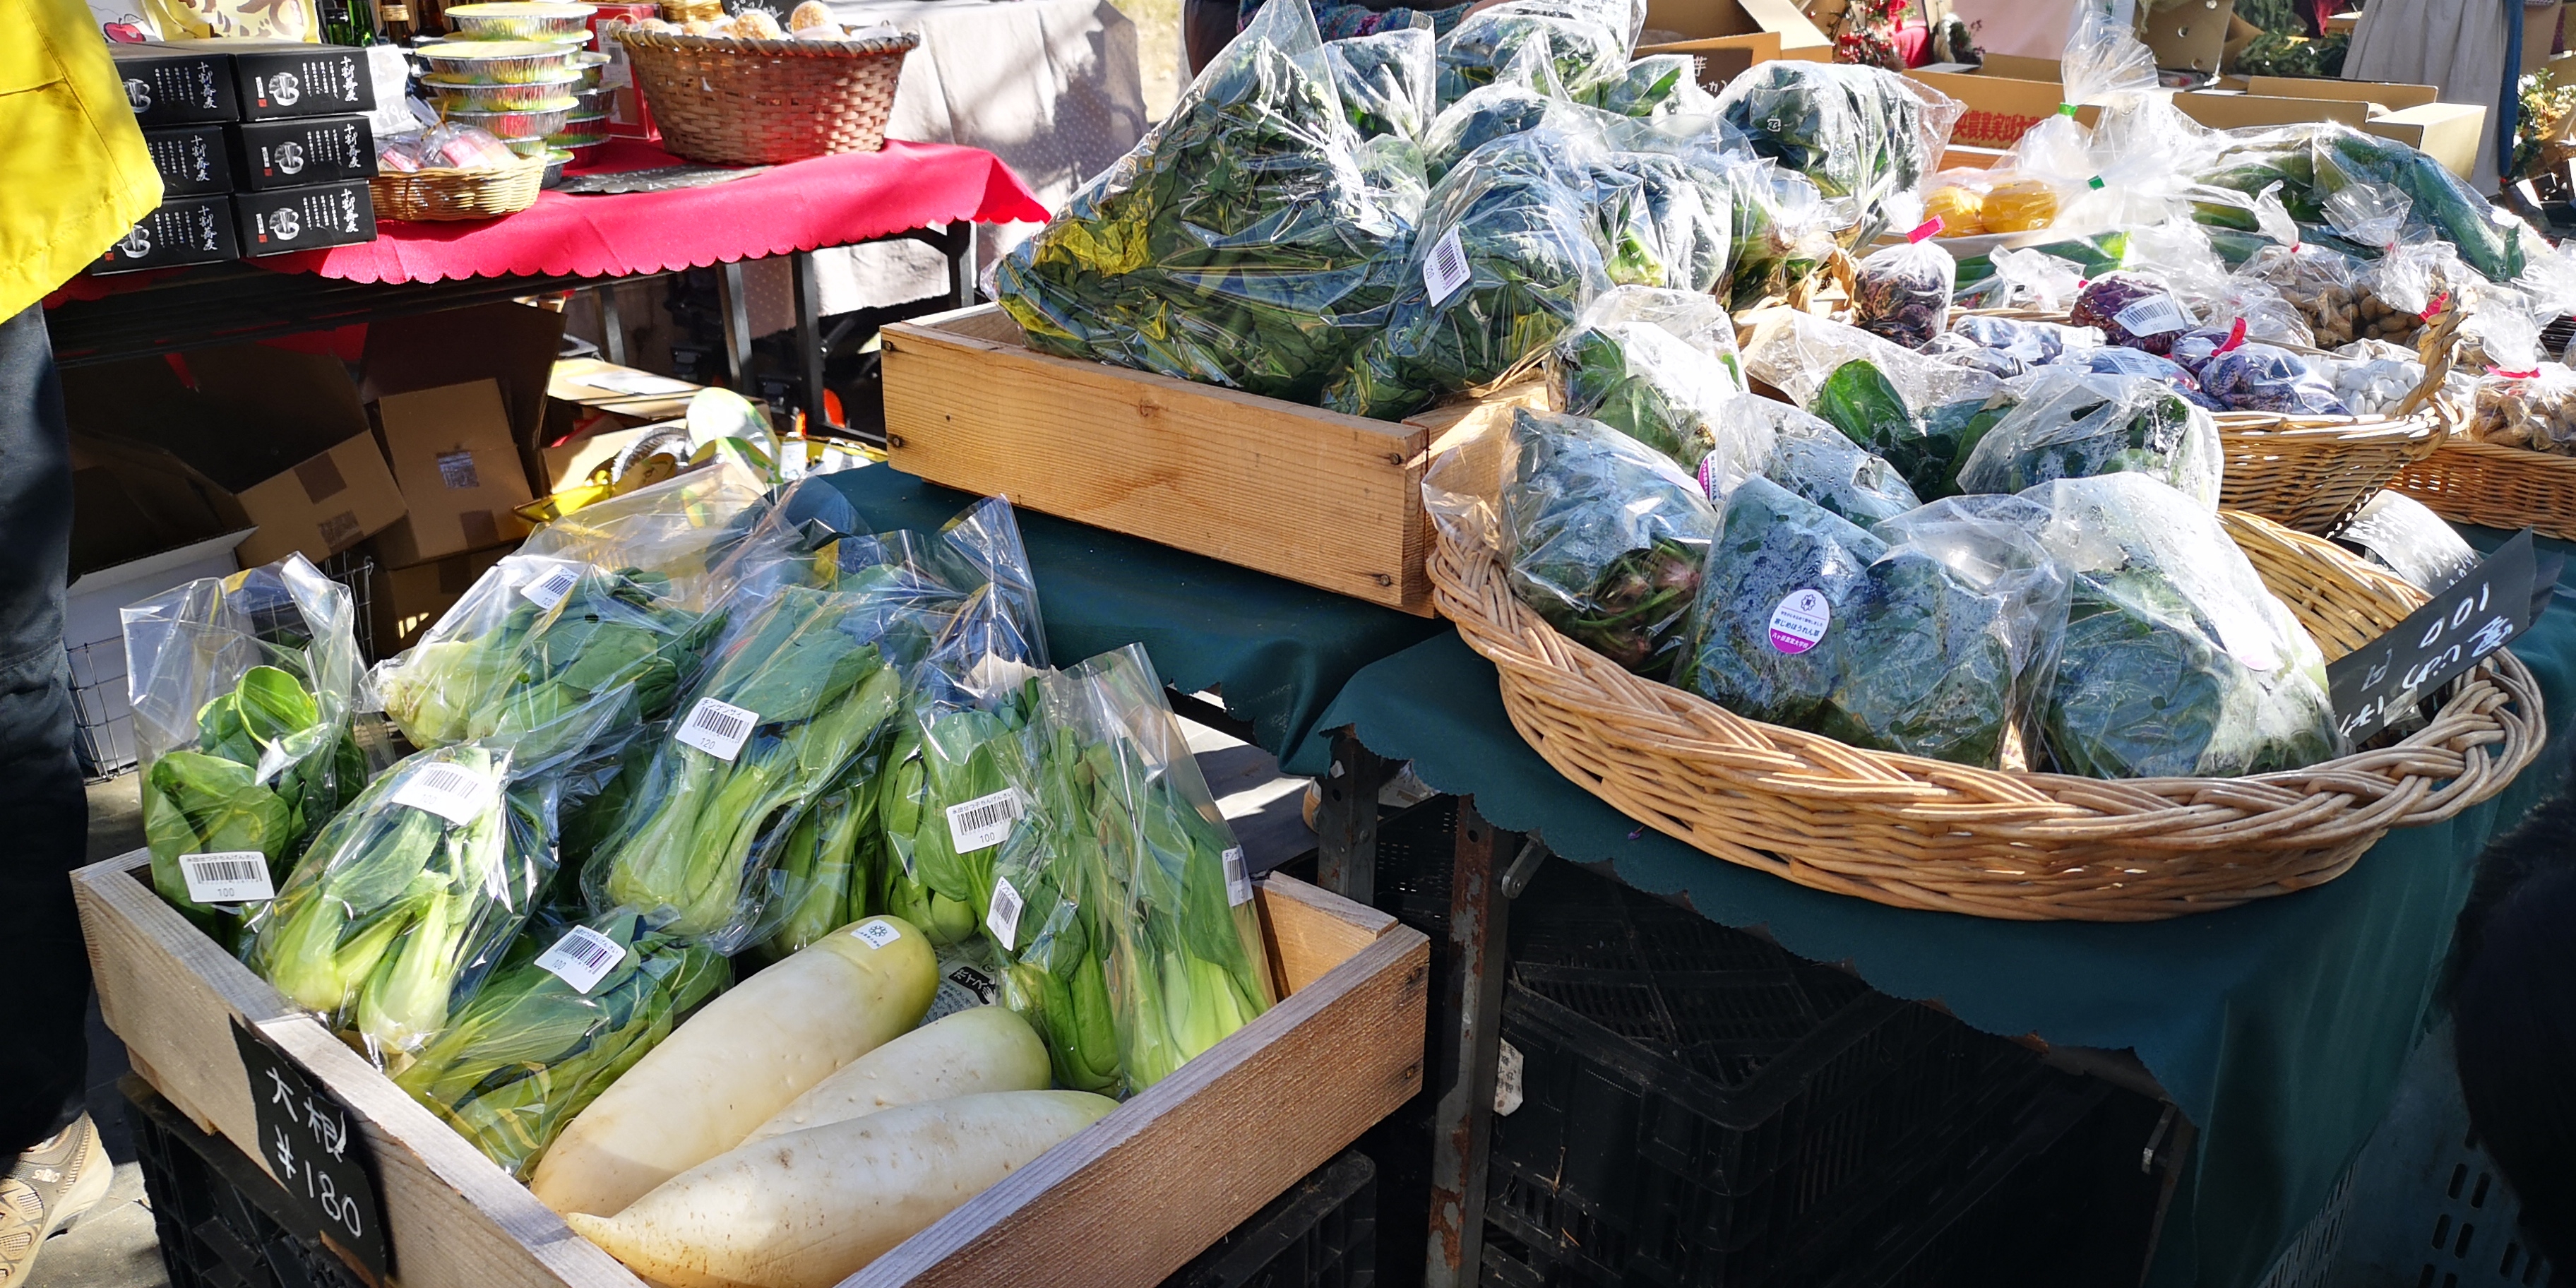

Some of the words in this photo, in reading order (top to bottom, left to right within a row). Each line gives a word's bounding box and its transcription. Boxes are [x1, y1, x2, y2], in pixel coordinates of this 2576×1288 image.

[197, 61, 217, 109] 十割蕎麦
[340, 56, 359, 102] 十割蕎麦
[191, 135, 210, 181] 十割蕎麦
[344, 123, 362, 169] 十割蕎麦
[198, 205, 217, 251] 十割蕎麦
[340, 188, 359, 233] 十割蕎麦
[702, 698, 743, 718] チンゲンサイ
[700, 738, 716, 750] 120
[979, 832, 996, 843] 100
[217, 887, 235, 898] 100
[552, 959, 567, 970] 100
[266, 1066, 347, 1164] 大根
[274, 1123, 362, 1239] ¥180
